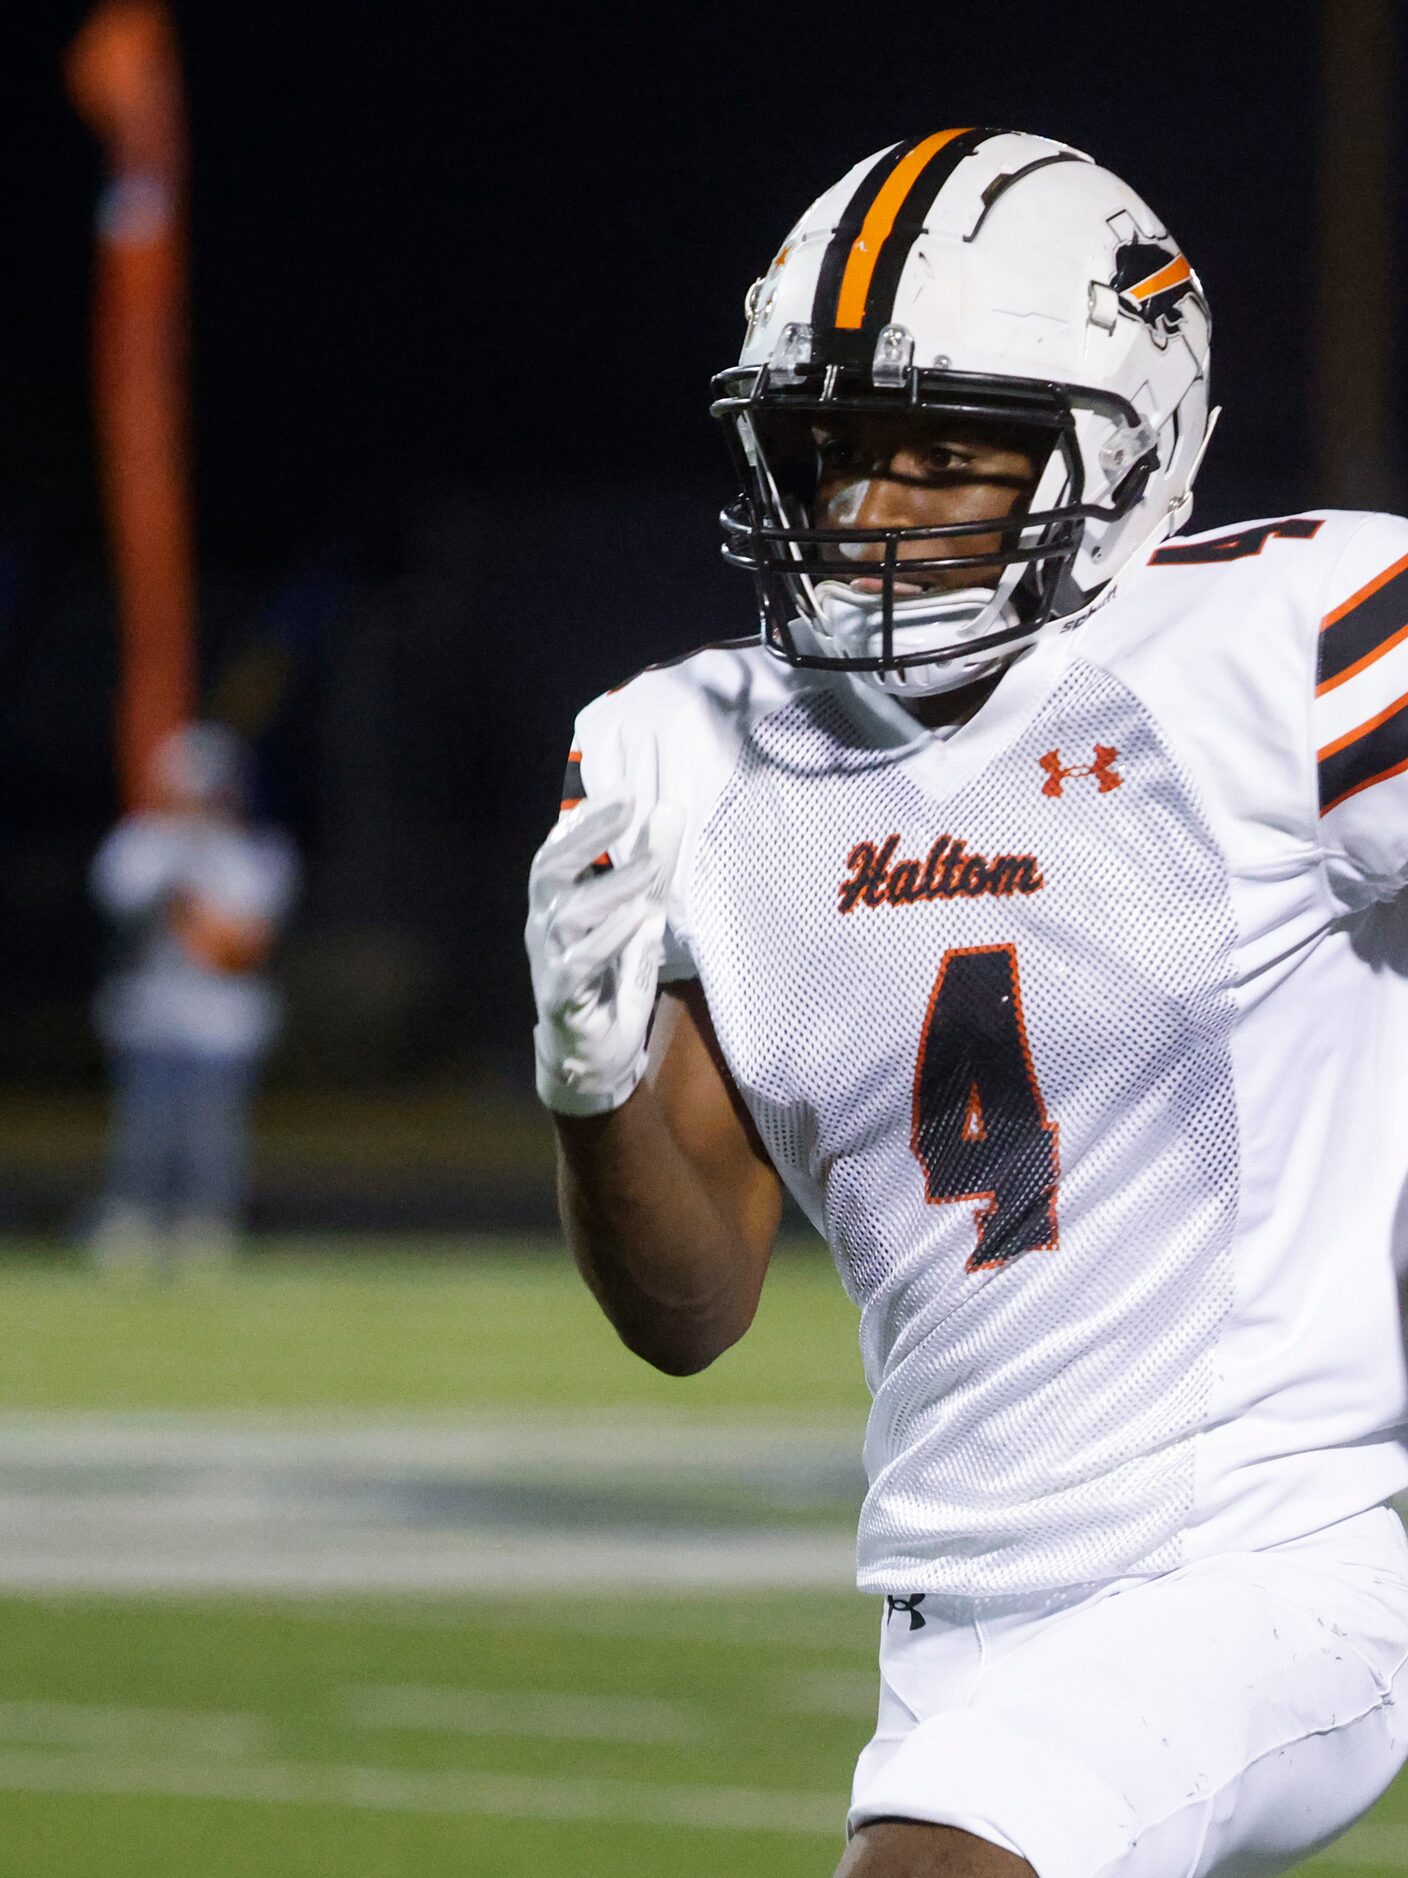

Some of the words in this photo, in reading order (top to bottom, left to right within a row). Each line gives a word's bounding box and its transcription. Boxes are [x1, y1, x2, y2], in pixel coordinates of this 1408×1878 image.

[1146, 518, 1326, 566] 4
[838, 834, 1045, 914] Haltom
[910, 943, 1060, 1274] 4
